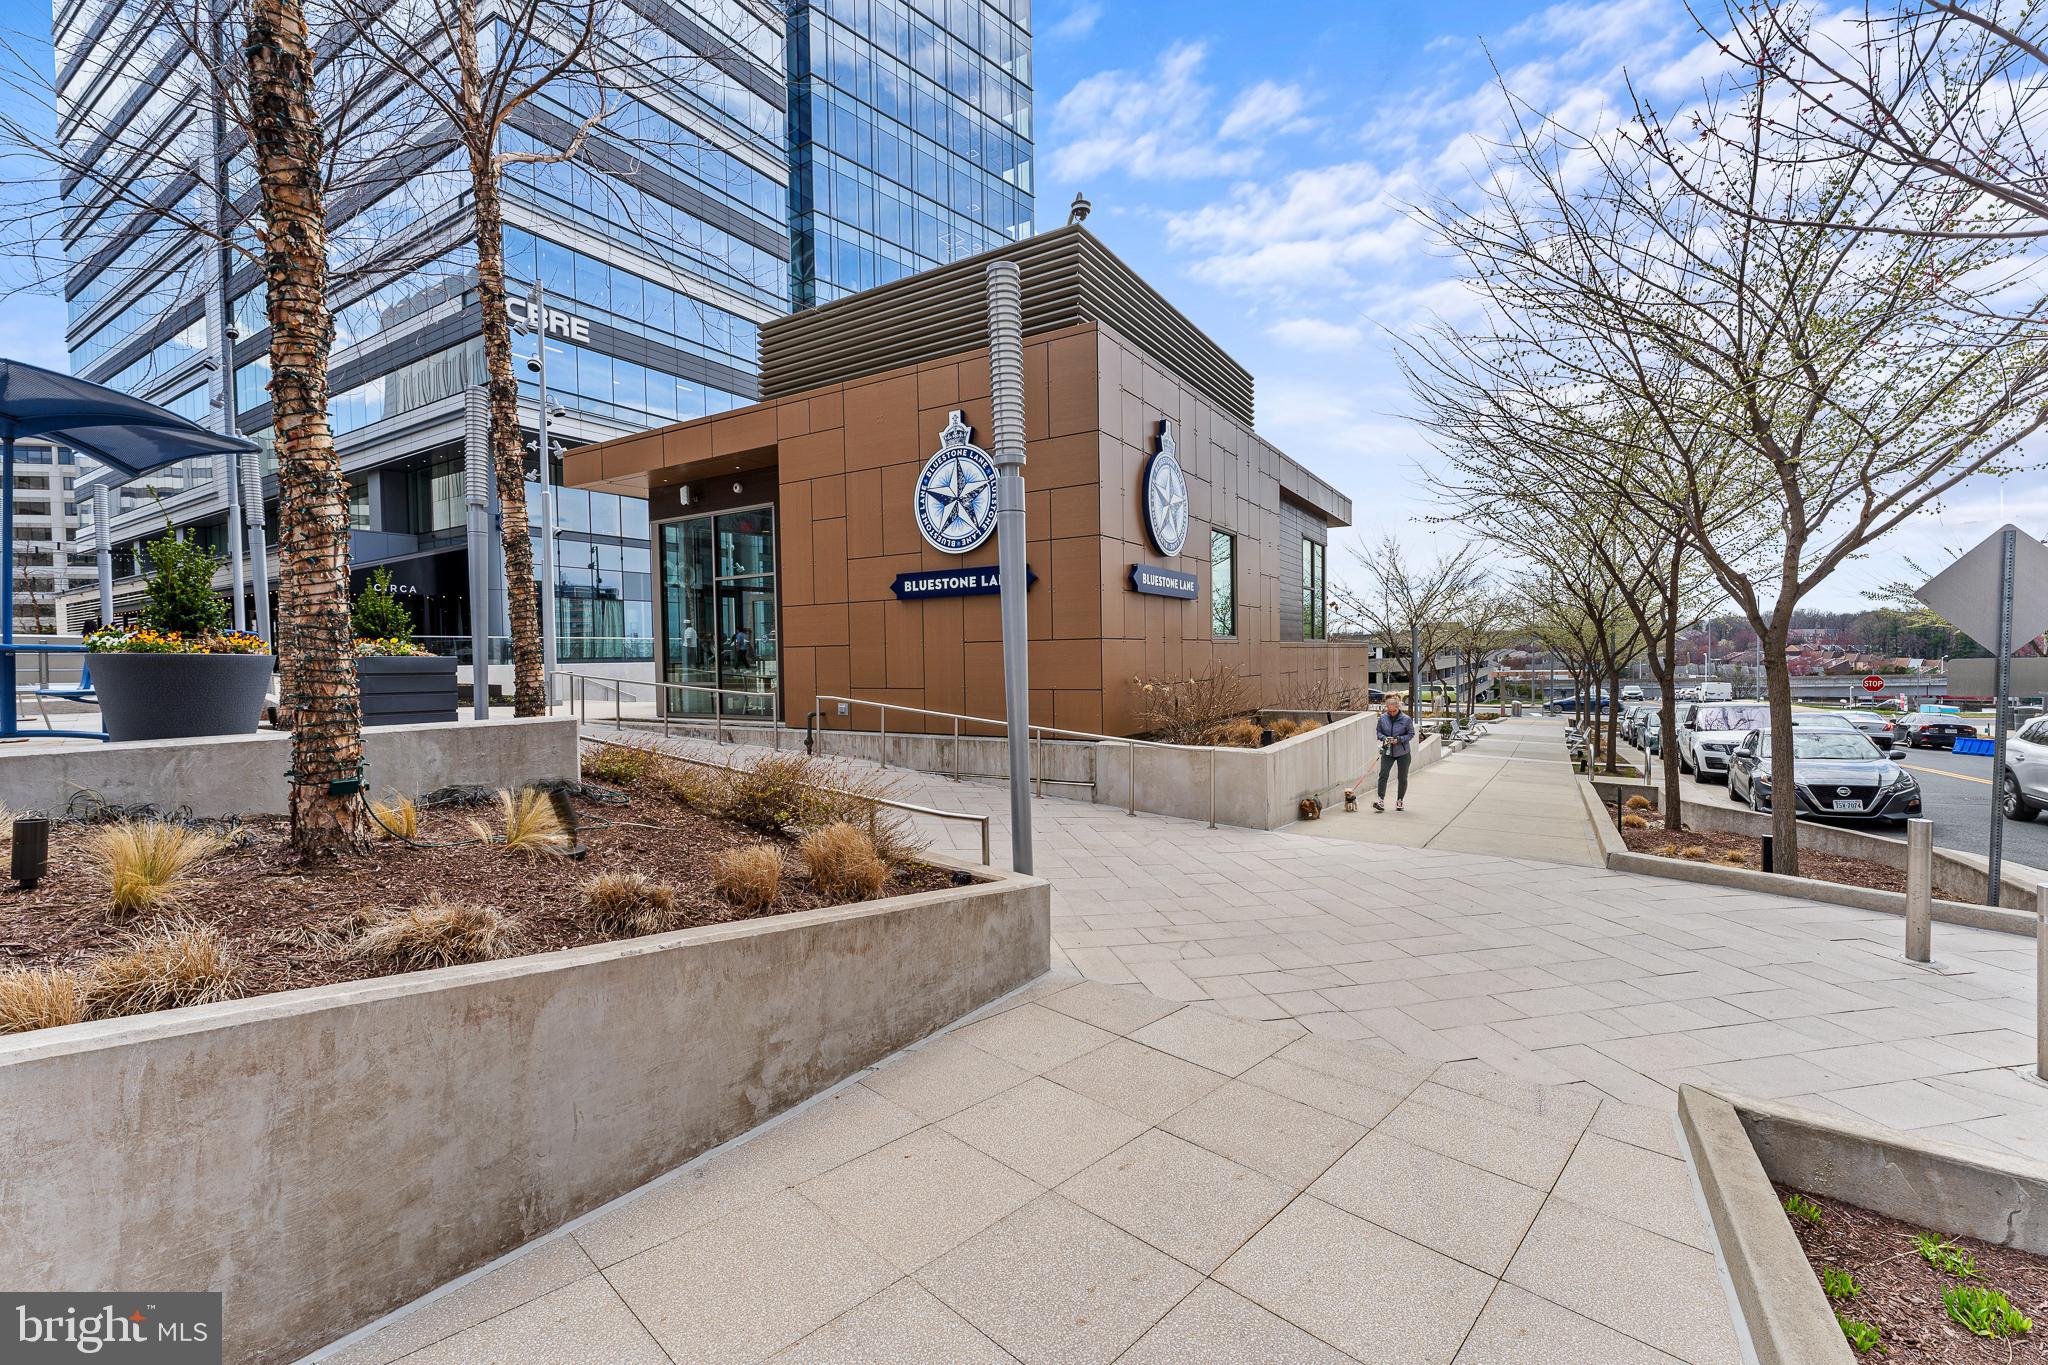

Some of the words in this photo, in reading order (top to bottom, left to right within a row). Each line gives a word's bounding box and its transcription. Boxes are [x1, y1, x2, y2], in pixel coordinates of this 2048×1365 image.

[505, 298, 590, 343] CBRE
[927, 450, 967, 478] BLUESTONE
[969, 452, 988, 469] LANE
[919, 485, 927, 510] LANE
[921, 510, 956, 547] BLUESTONE
[961, 529, 982, 547] LANE
[904, 576, 977, 592] BLUESTONE
[981, 574, 1000, 587] LA
[1142, 573, 1178, 589] BLUESTONE
[1179, 579, 1195, 592] LANE
[1863, 680, 1883, 688] STOP
